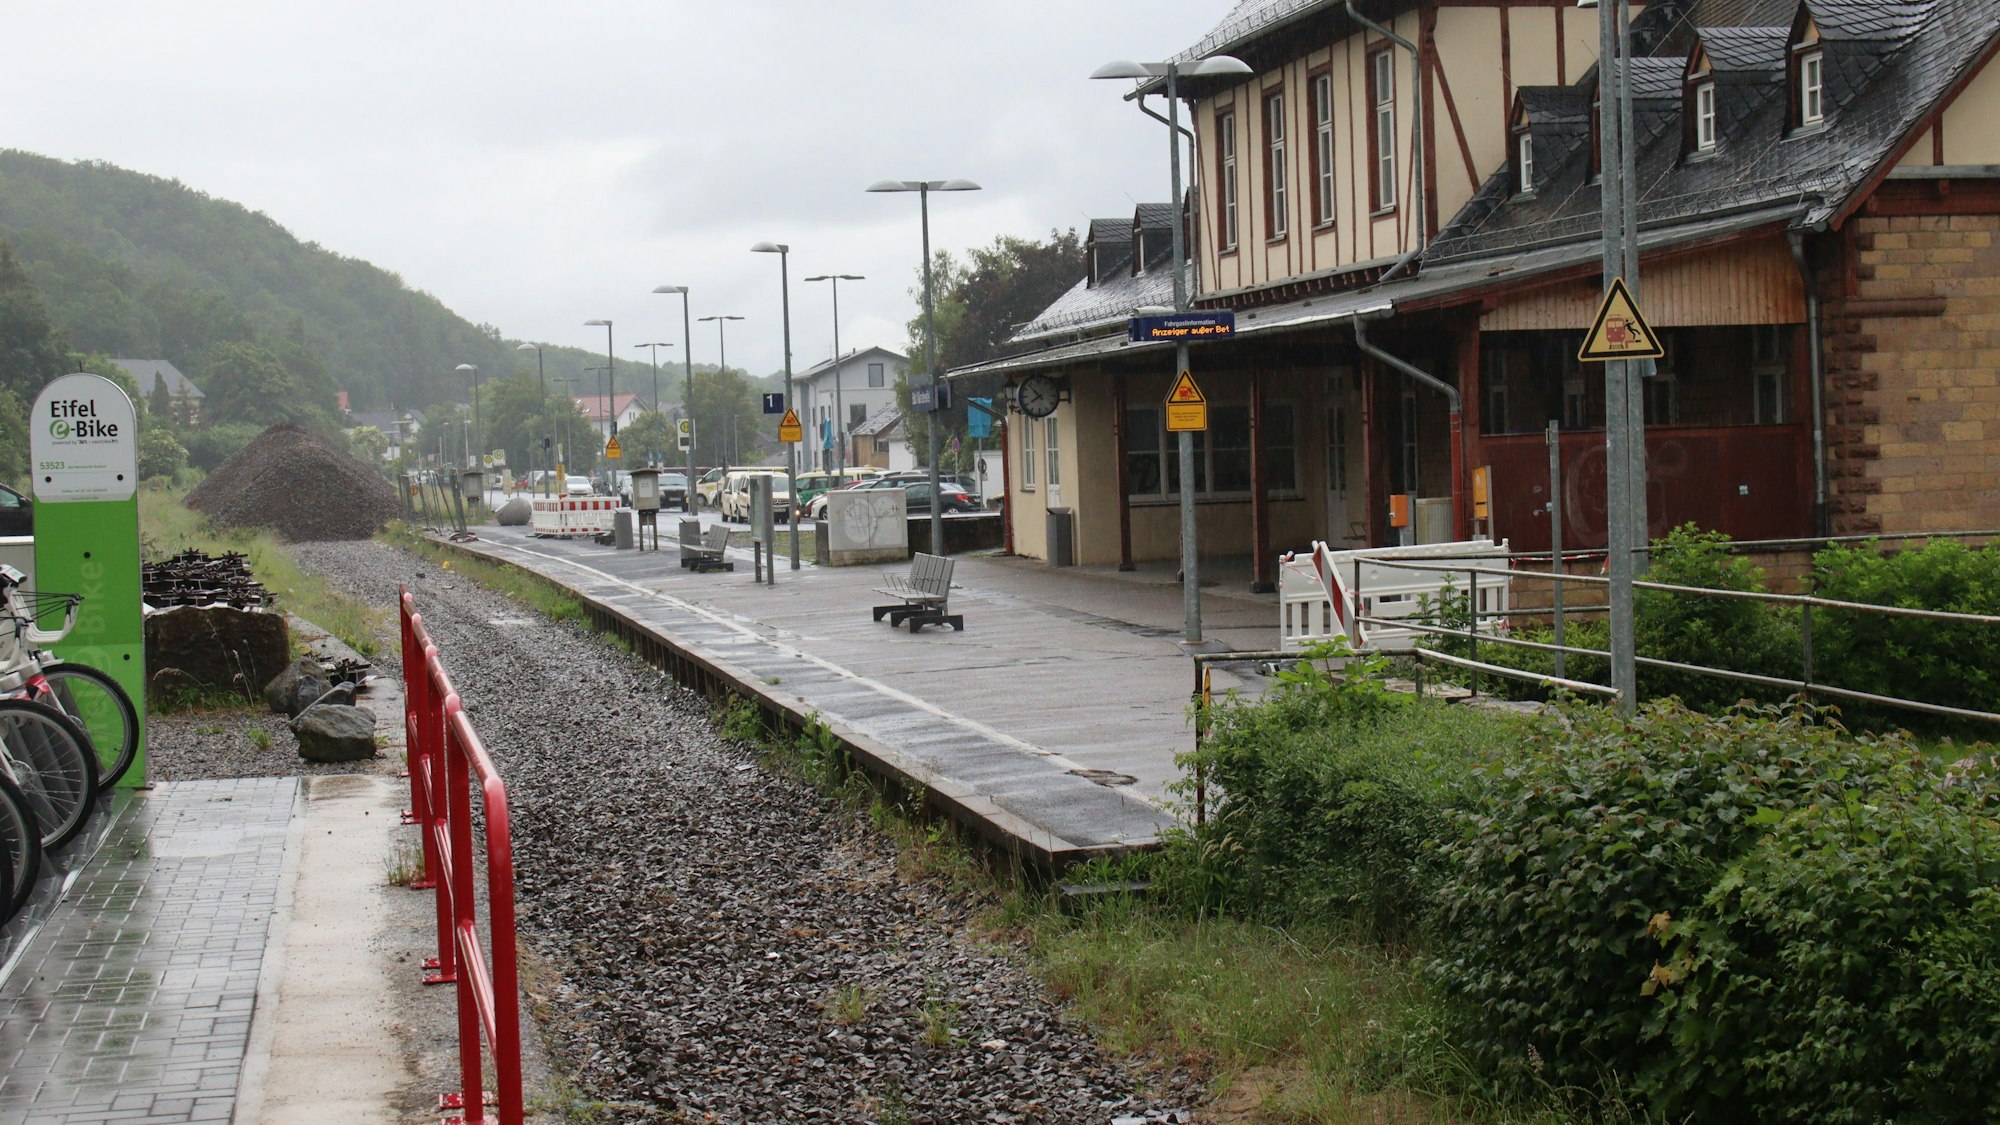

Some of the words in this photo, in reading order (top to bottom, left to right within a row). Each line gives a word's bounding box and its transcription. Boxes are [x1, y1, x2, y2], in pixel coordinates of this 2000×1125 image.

[1164, 319, 1216, 328] Fahrgastinformation
[1152, 328, 1189, 337] Anzeiger
[1191, 326, 1214, 335] außer
[1215, 325, 1230, 334] Bet
[766, 394, 773, 408] 1
[51, 399, 96, 418] Eifel
[50, 419, 119, 440] e-Bike
[40, 461, 65, 470] 53523
